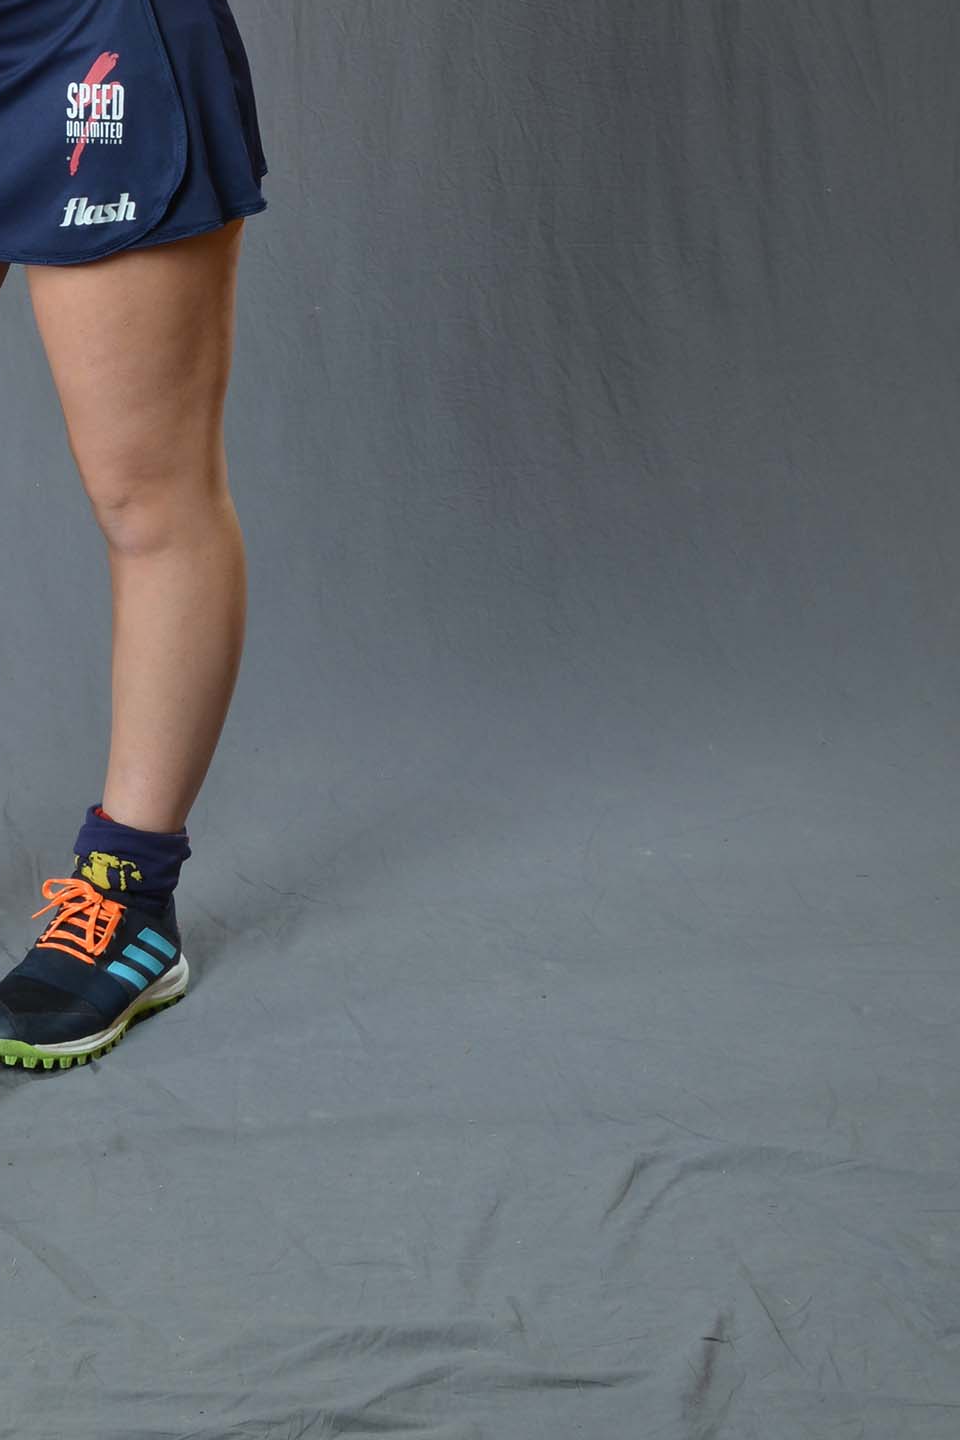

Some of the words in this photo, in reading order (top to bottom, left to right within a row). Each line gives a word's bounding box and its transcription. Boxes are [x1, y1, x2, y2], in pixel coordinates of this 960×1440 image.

[66, 82, 125, 120] SPEED
[66, 120, 123, 138] UNLIMITED
[59, 193, 137, 227] flash
